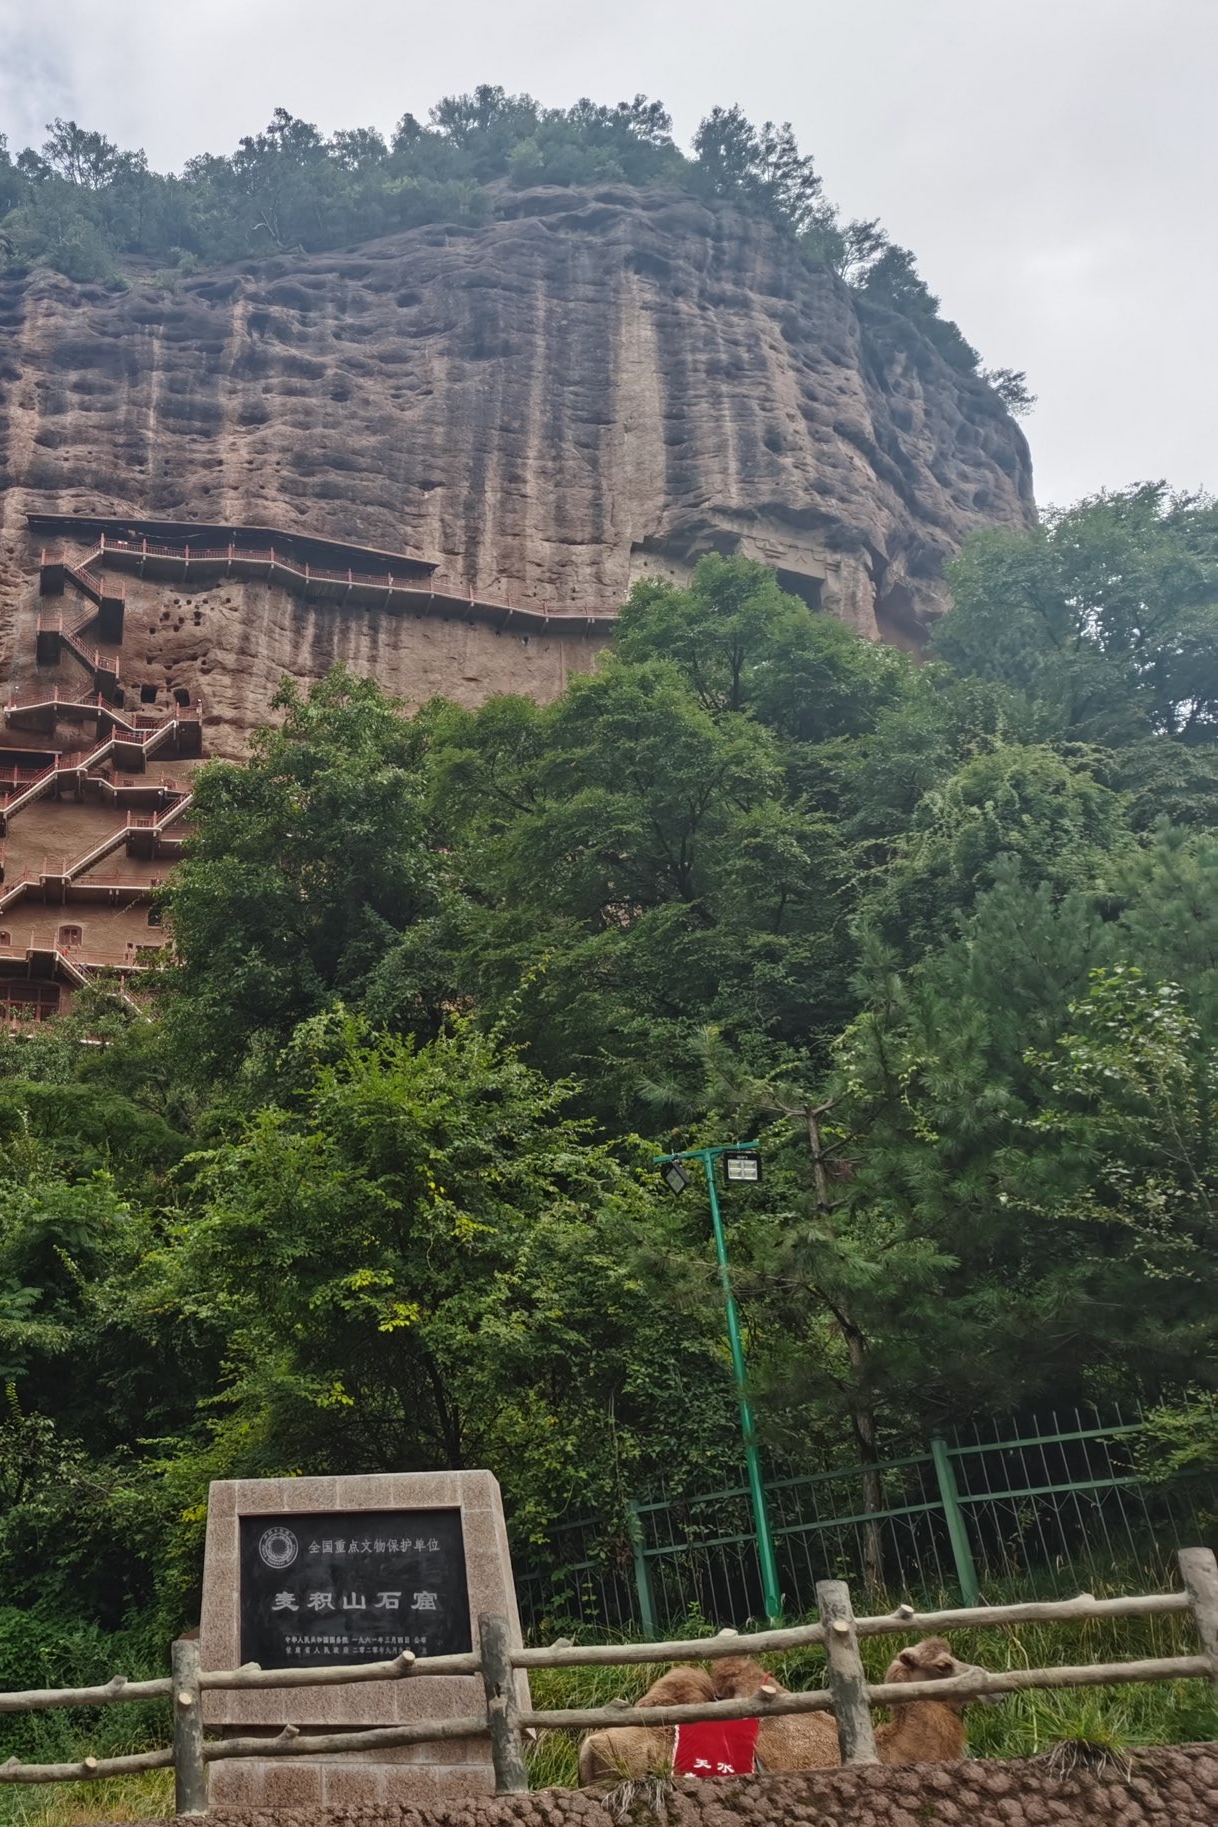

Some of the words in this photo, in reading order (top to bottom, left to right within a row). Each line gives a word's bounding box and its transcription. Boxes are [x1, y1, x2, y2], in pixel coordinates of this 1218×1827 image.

[308, 1538, 440, 1555] 全国重点文物保护单位
[272, 1590, 439, 1612] 麦积山石窟
[285, 1635, 349, 1644] 中华人民共和国国务院
[285, 1646, 349, 1655] 甘肃省人民政府
[693, 1758, 735, 1774] 天水
